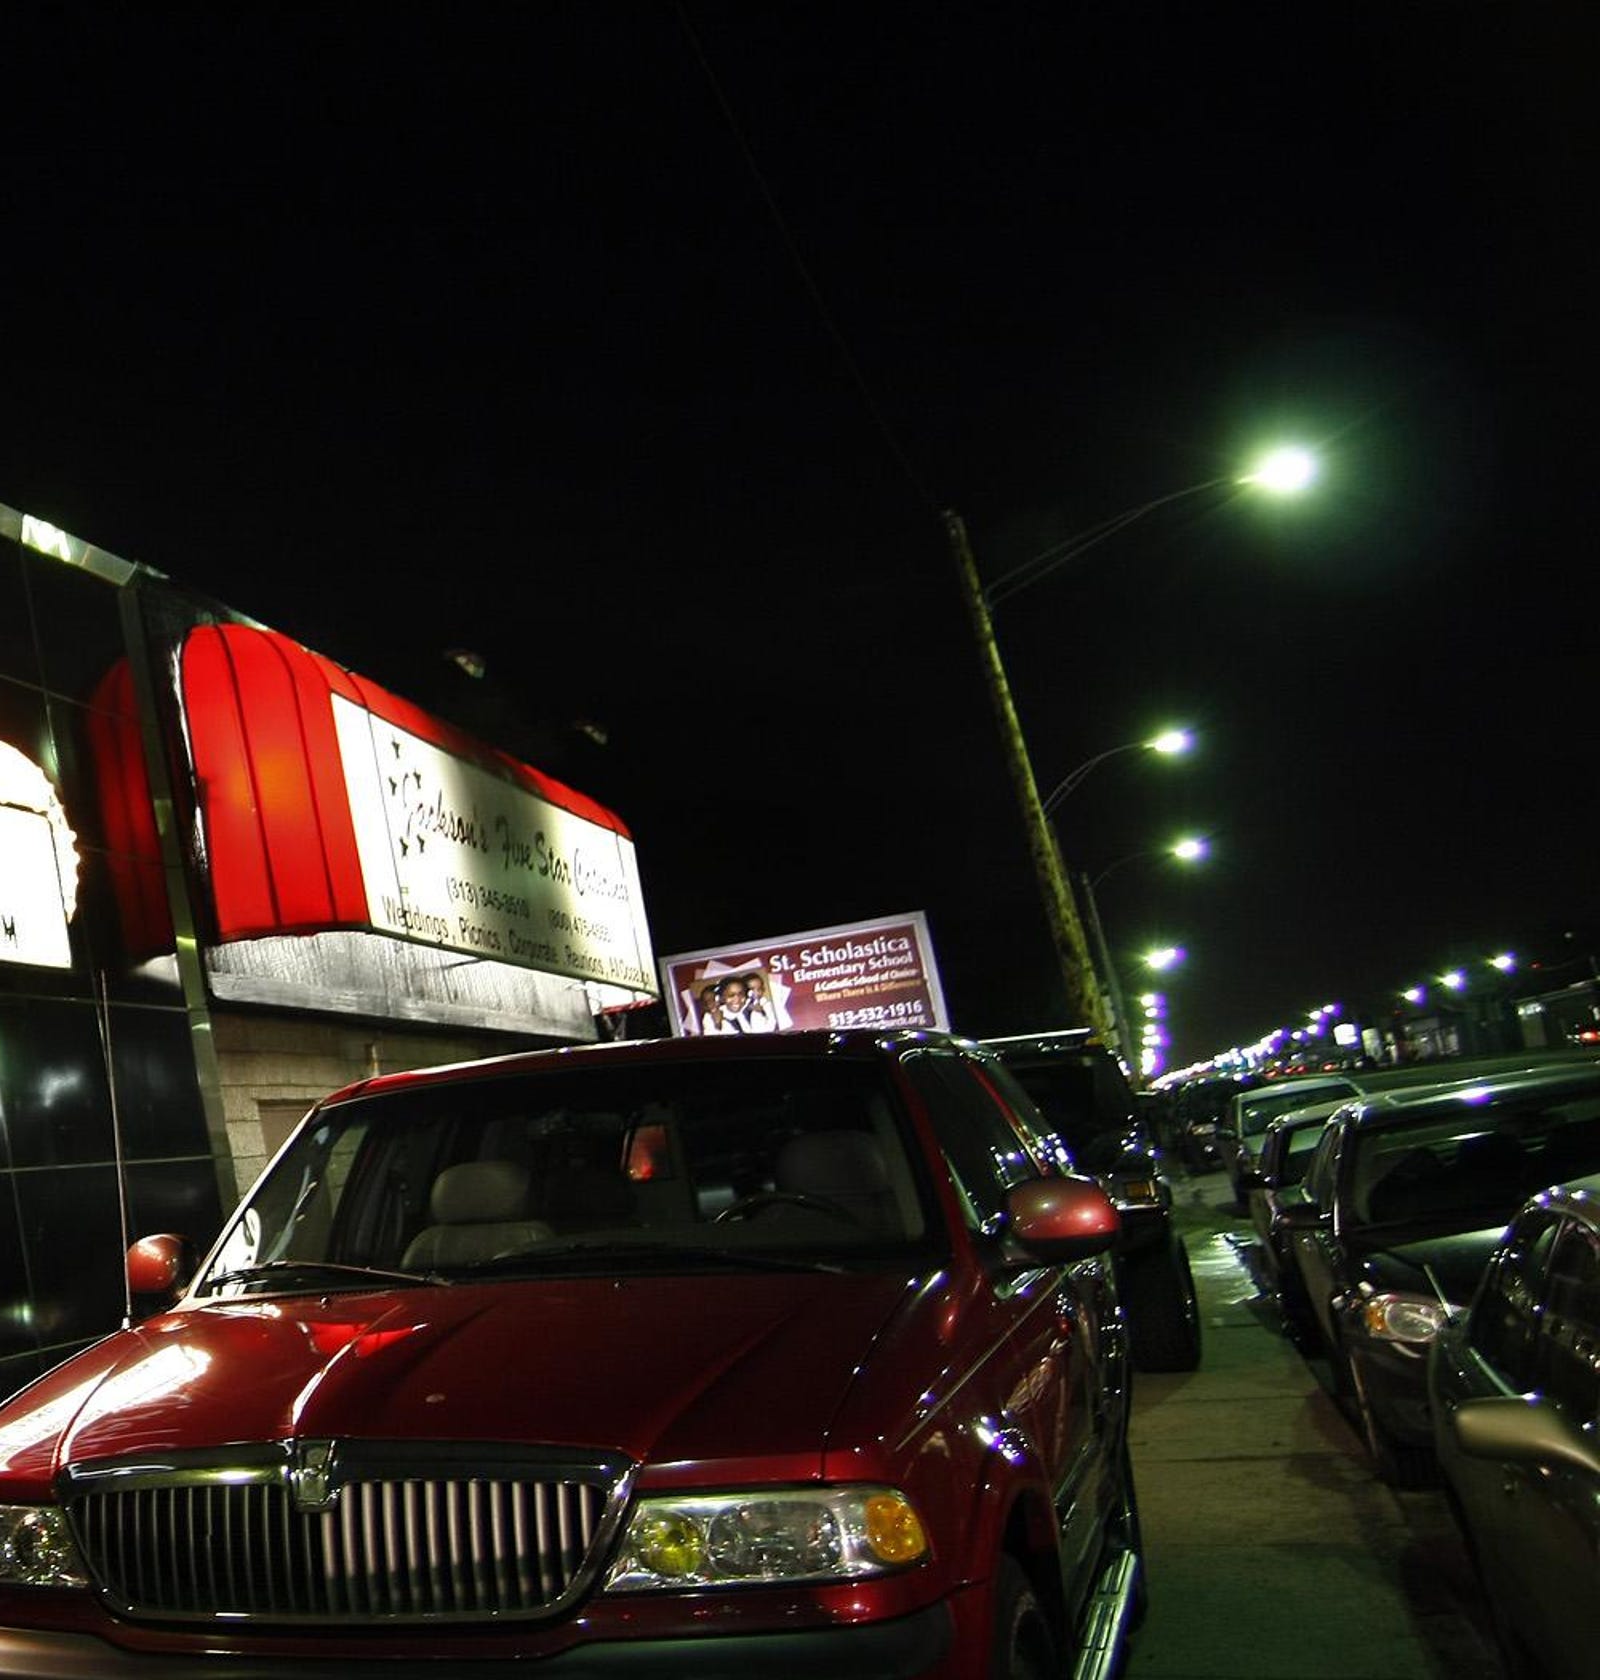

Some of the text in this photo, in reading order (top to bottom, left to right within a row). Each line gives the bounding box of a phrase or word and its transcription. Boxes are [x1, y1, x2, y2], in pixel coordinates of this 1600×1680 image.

[535, 831, 572, 885] Star
[769, 936, 910, 973] St. Scholastica
[793, 951, 913, 983] Elementary School
[828, 1000, 923, 1027] 313-532-1916
